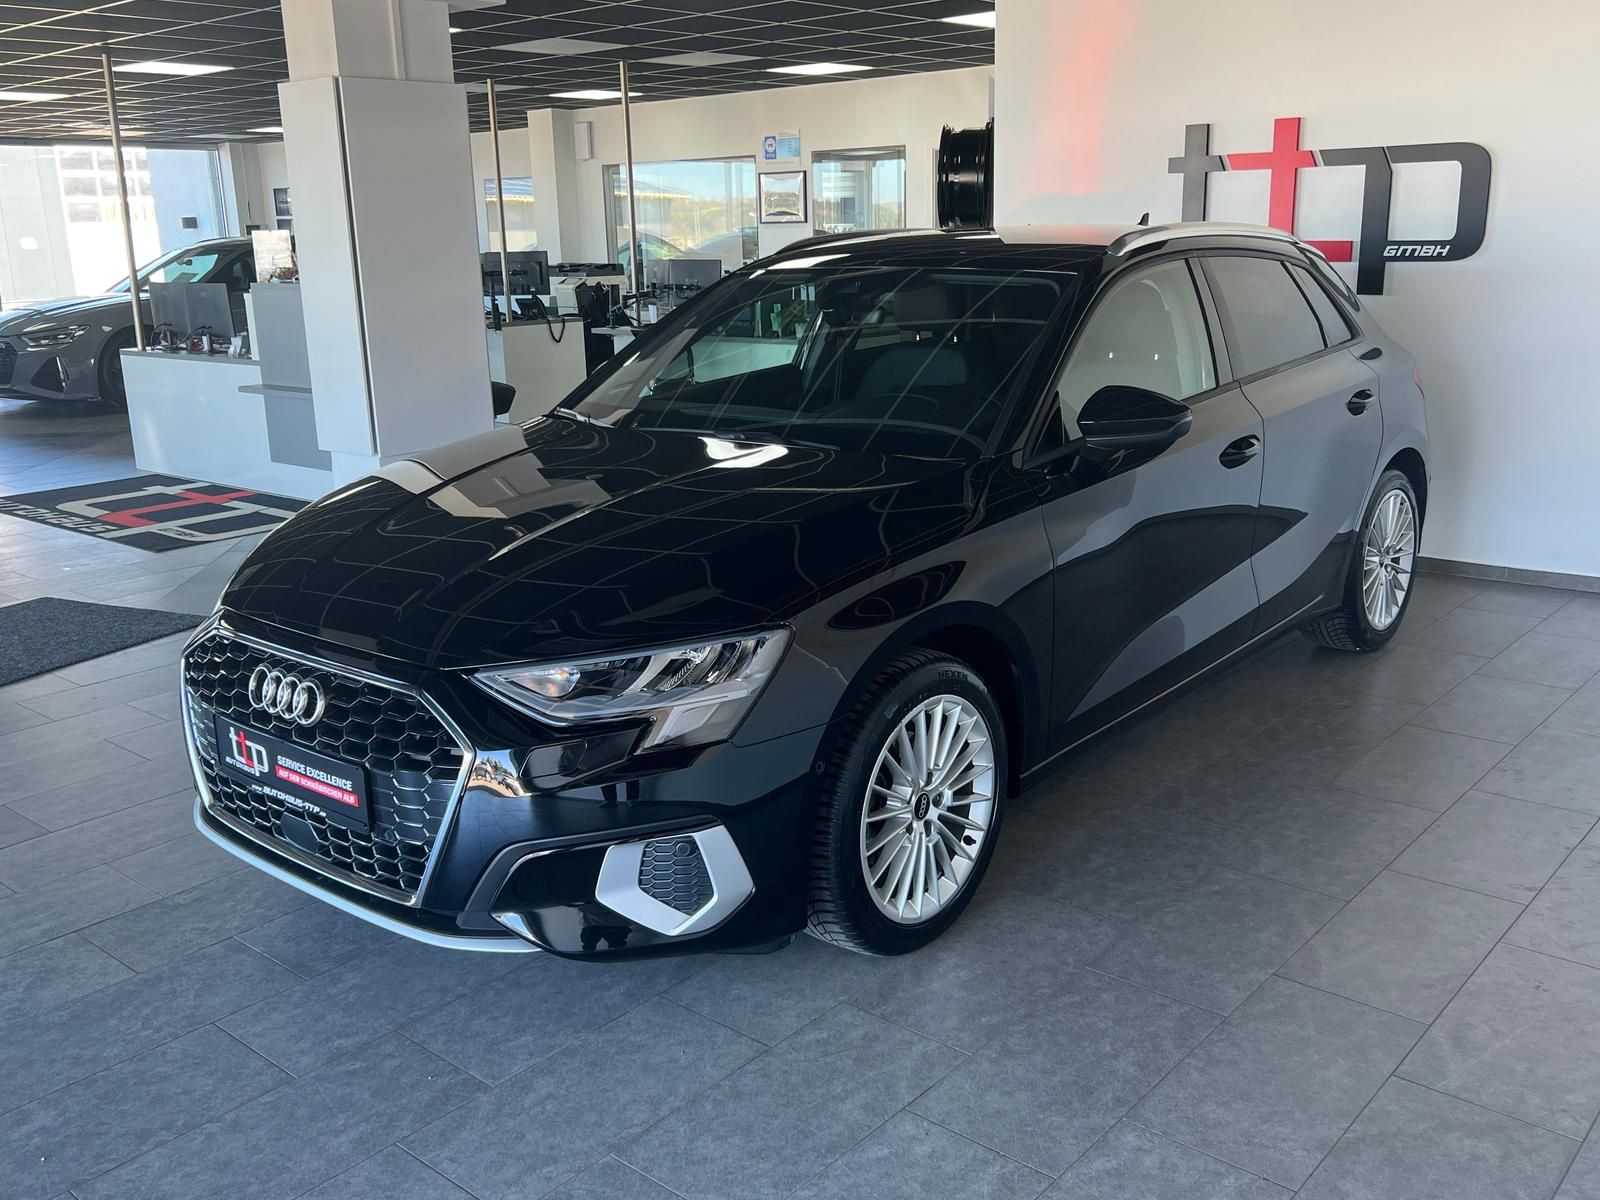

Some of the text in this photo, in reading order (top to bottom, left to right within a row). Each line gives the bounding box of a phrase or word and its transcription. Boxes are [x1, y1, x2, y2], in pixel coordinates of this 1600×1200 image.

[937, 669, 968, 680] NEXEN
[277, 755, 353, 791] SERVICE EXCELLENCE
[343, 794, 355, 803] ALB
